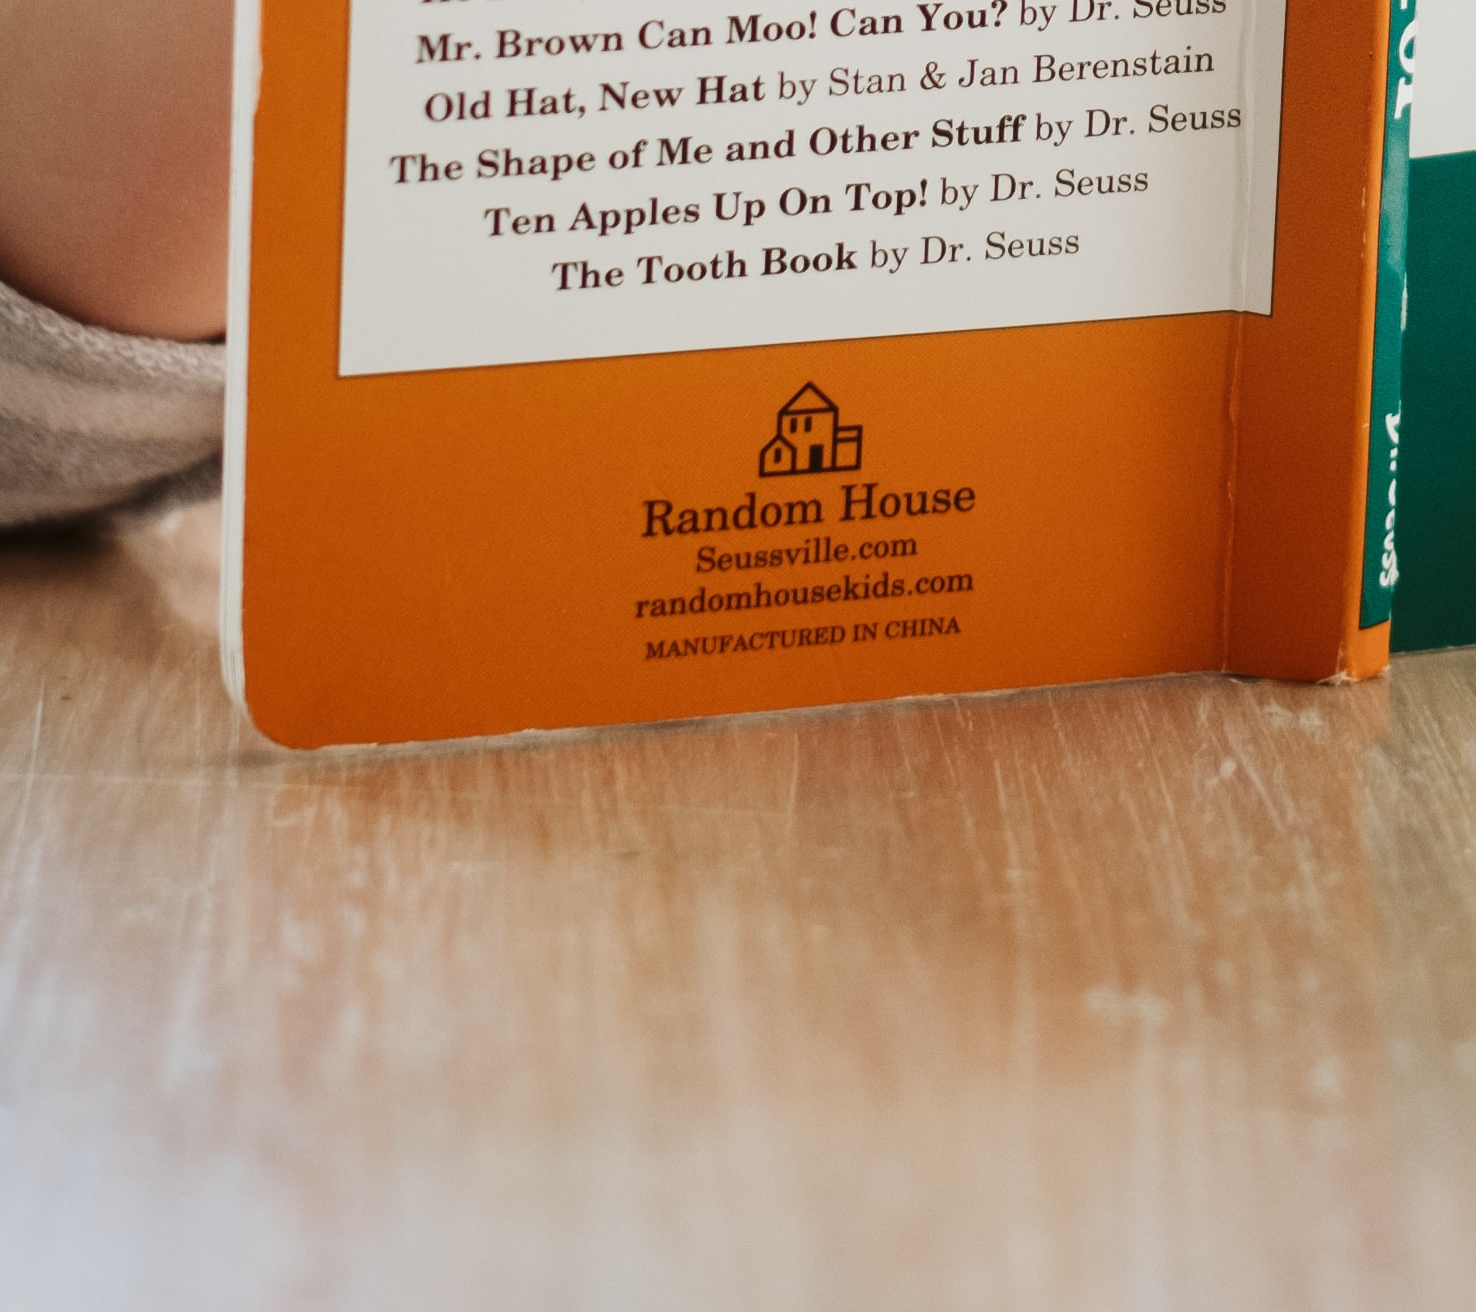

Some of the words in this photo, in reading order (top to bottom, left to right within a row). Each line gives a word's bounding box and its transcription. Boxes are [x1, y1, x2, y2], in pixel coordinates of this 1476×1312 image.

[416, 33, 481, 64] Mr.
[496, 29, 623, 59] Brown
[638, 20, 712, 49] Can
[726, 10, 817, 44] Moo!
[830, 8, 903, 37] Can
[917, 0, 1008, 32] You?
[424, 90, 491, 122] Old
[506, 87, 586, 118] Hat,
[599, 82, 683, 111] New
[696, 75, 765, 105] Hat
[779, 71, 816, 106] by
[829, 68, 906, 96] Stan
[920, 61, 946, 90] &
[958, 59, 1019, 88] Jan
[1033, 46, 1214, 83] Berenstain
[390, 153, 463, 184] The
[477, 148, 595, 181] Shape
[608, 139, 648, 170] of
[656, 136, 713, 166] Me
[725, 129, 795, 162] and
[809, 125, 920, 156] Other
[931, 114, 1027, 148] Stuff
[1036, 113, 1073, 147] by
[1085, 109, 1134, 137] Dr.
[1148, 104, 1241, 133] Seuss
[484, 207, 555, 237] Ten
[569, 197, 700, 237] Apples
[713, 191, 766, 227] Up
[779, 187, 831, 216] On
[845, 178, 928, 216] Top!
[941, 177, 978, 211] by
[990, 173, 1040, 202] Dr.
[1055, 169, 1148, 197] Seuss
[551, 260, 624, 291] The
[637, 250, 747, 285] Tooth
[761, 242, 857, 276] Book
[871, 240, 908, 274] by
[921, 236, 971, 264] Dr.
[985, 232, 1079, 260] Seuss
[641, 492, 824, 538] Random
[839, 482, 976, 522] House
[696, 536, 917, 573] Seussville.com
[635, 571, 973, 619] randomhousekids.com
[645, 626, 846, 660] MANUFACTURED
[853, 623, 878, 642] IN
[885, 617, 961, 639] CHINA
